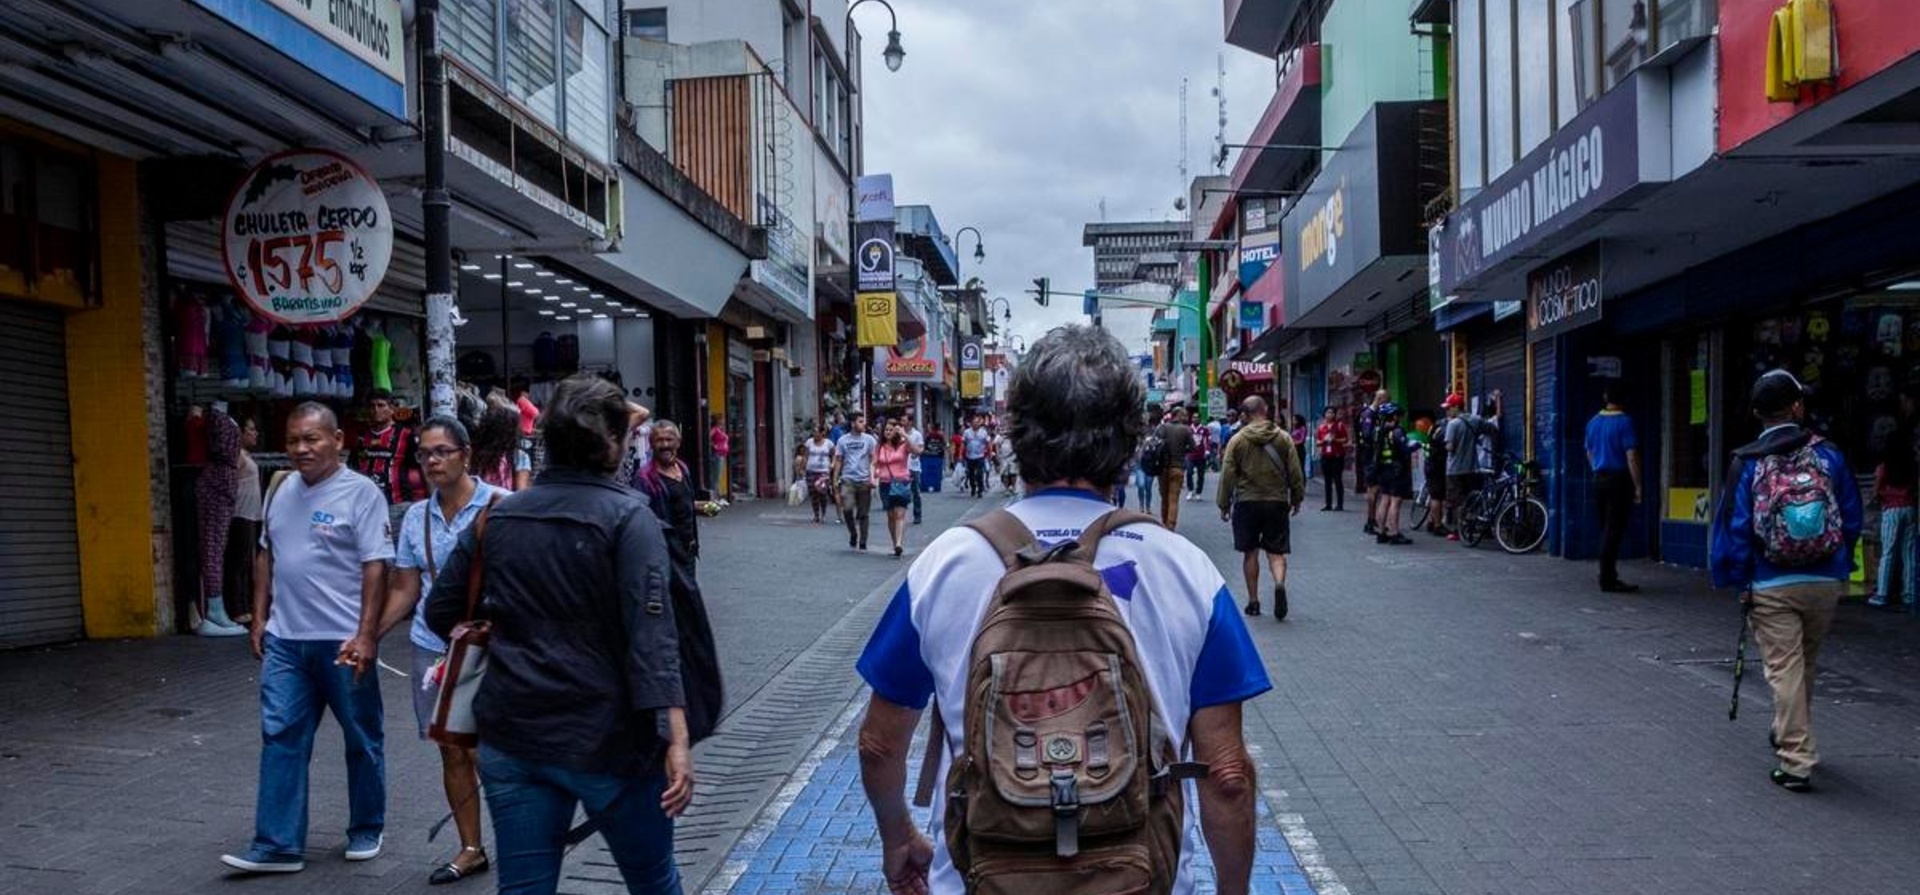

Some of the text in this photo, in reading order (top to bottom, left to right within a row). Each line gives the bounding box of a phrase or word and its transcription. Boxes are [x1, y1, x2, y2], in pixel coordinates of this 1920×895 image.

[234, 204, 377, 236] CHULETA CERDO
[1481, 124, 1604, 259] MUNDO MÁGICO
[1241, 246, 1278, 264] HOTEL
[1301, 188, 1344, 272] monge
